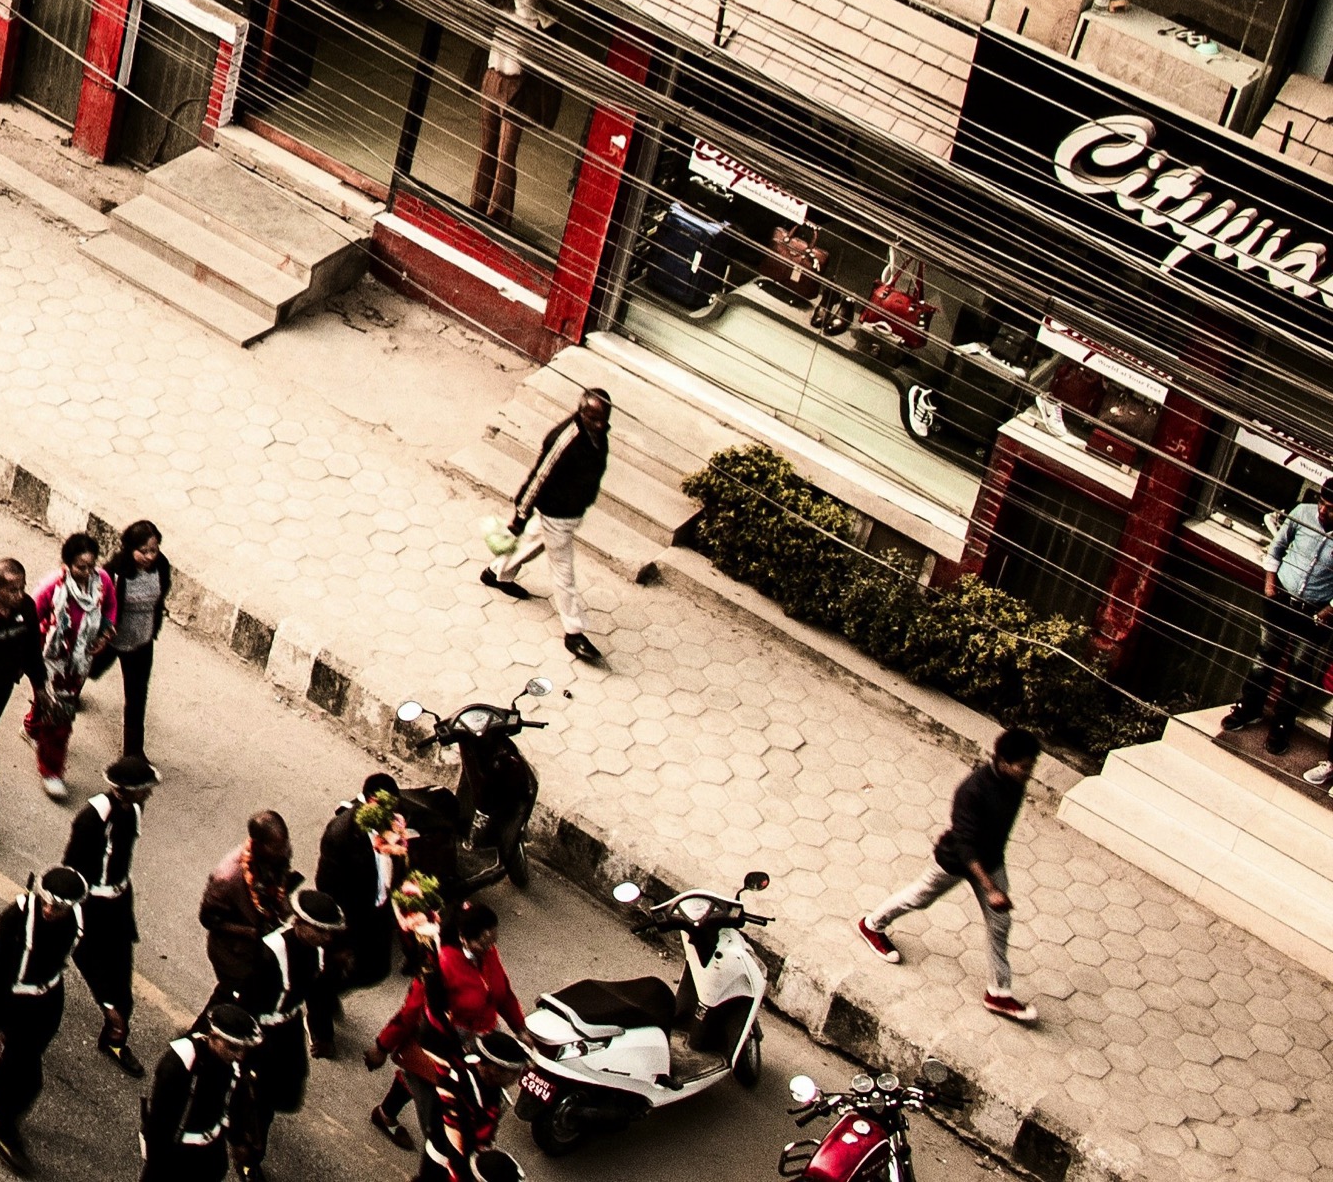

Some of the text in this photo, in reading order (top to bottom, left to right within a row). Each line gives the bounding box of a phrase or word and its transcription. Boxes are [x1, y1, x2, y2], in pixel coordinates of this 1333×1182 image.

[1054, 114, 1333, 309] Citywa
[1097, 357, 1120, 374] World
[1128, 374, 1145, 386] Your
[1146, 382, 1163, 395] Feet
[1299, 460, 1324, 478] World
